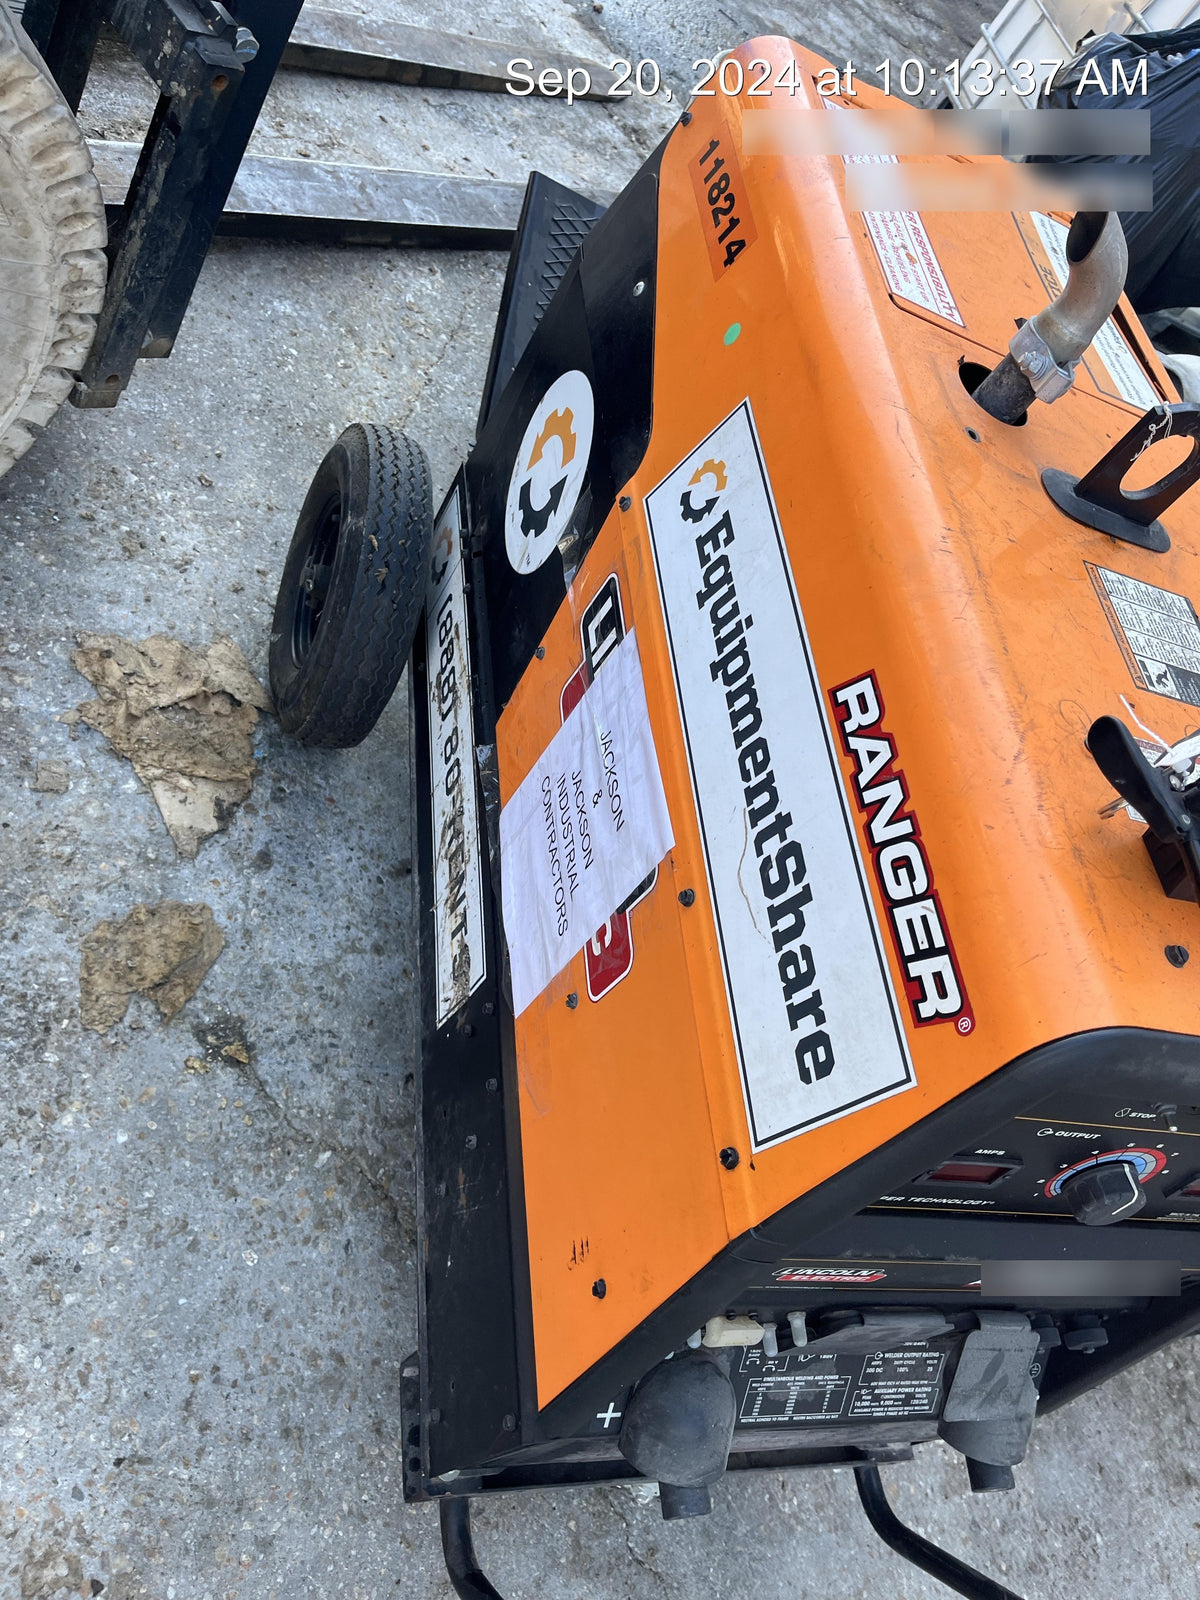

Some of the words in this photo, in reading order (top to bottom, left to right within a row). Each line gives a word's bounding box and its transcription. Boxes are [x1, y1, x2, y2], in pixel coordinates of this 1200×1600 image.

[699, 138, 748, 268] 118214
[910, 225, 957, 321] RESPONSIBILITY
[572, 770, 594, 870] JACKSON
[593, 789, 602, 808] &
[601, 730, 624, 832] JACKSON
[694, 511, 835, 1085] EquipmentShare
[541, 776, 568, 937] CONTRACTORS
[557, 773, 579, 902] INDUSTRIAL
[1055, 1131, 1101, 1139] OUTPUT
[781, 1268, 877, 1276] LINCOLN
